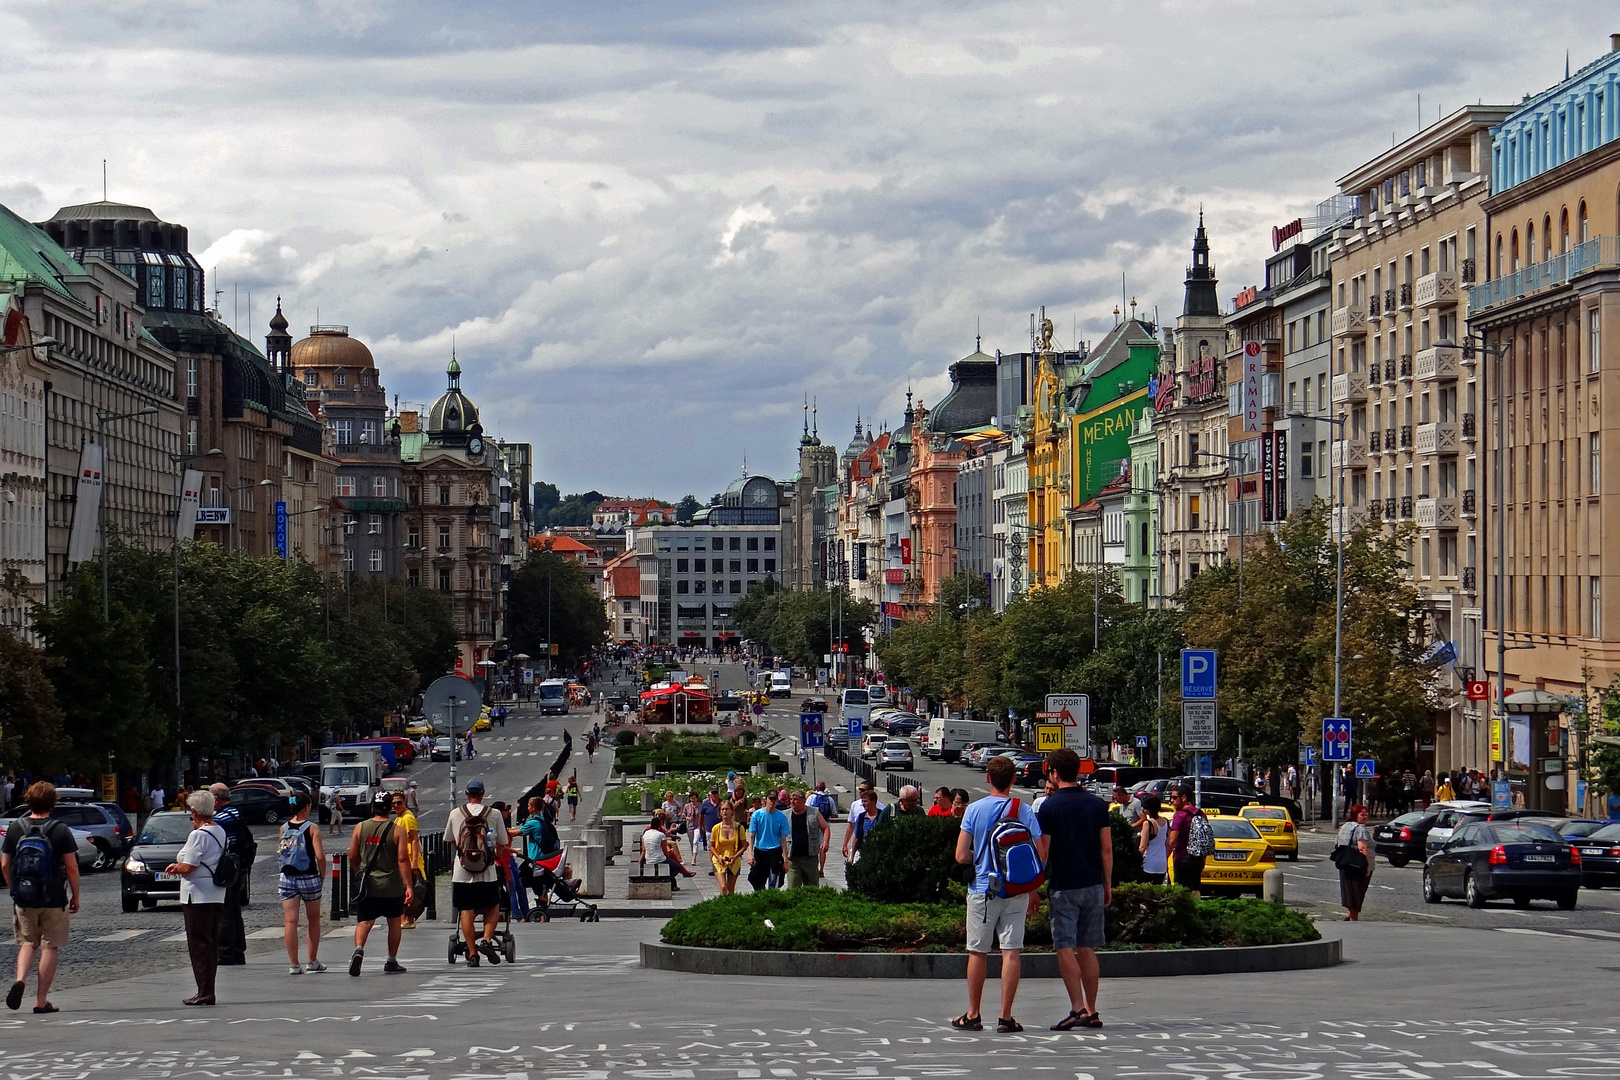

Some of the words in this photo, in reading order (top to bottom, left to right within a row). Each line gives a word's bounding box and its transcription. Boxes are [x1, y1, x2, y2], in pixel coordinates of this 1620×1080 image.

[1248, 363, 1258, 431] RAMADA
[1083, 409, 1135, 445] MERAN
[1264, 438, 1272, 481] Elysee
[1278, 435, 1286, 480] Elysee
[1189, 656, 1208, 684] P
[851, 720, 859, 732] P
[1041, 733, 1059, 744] TAXI
